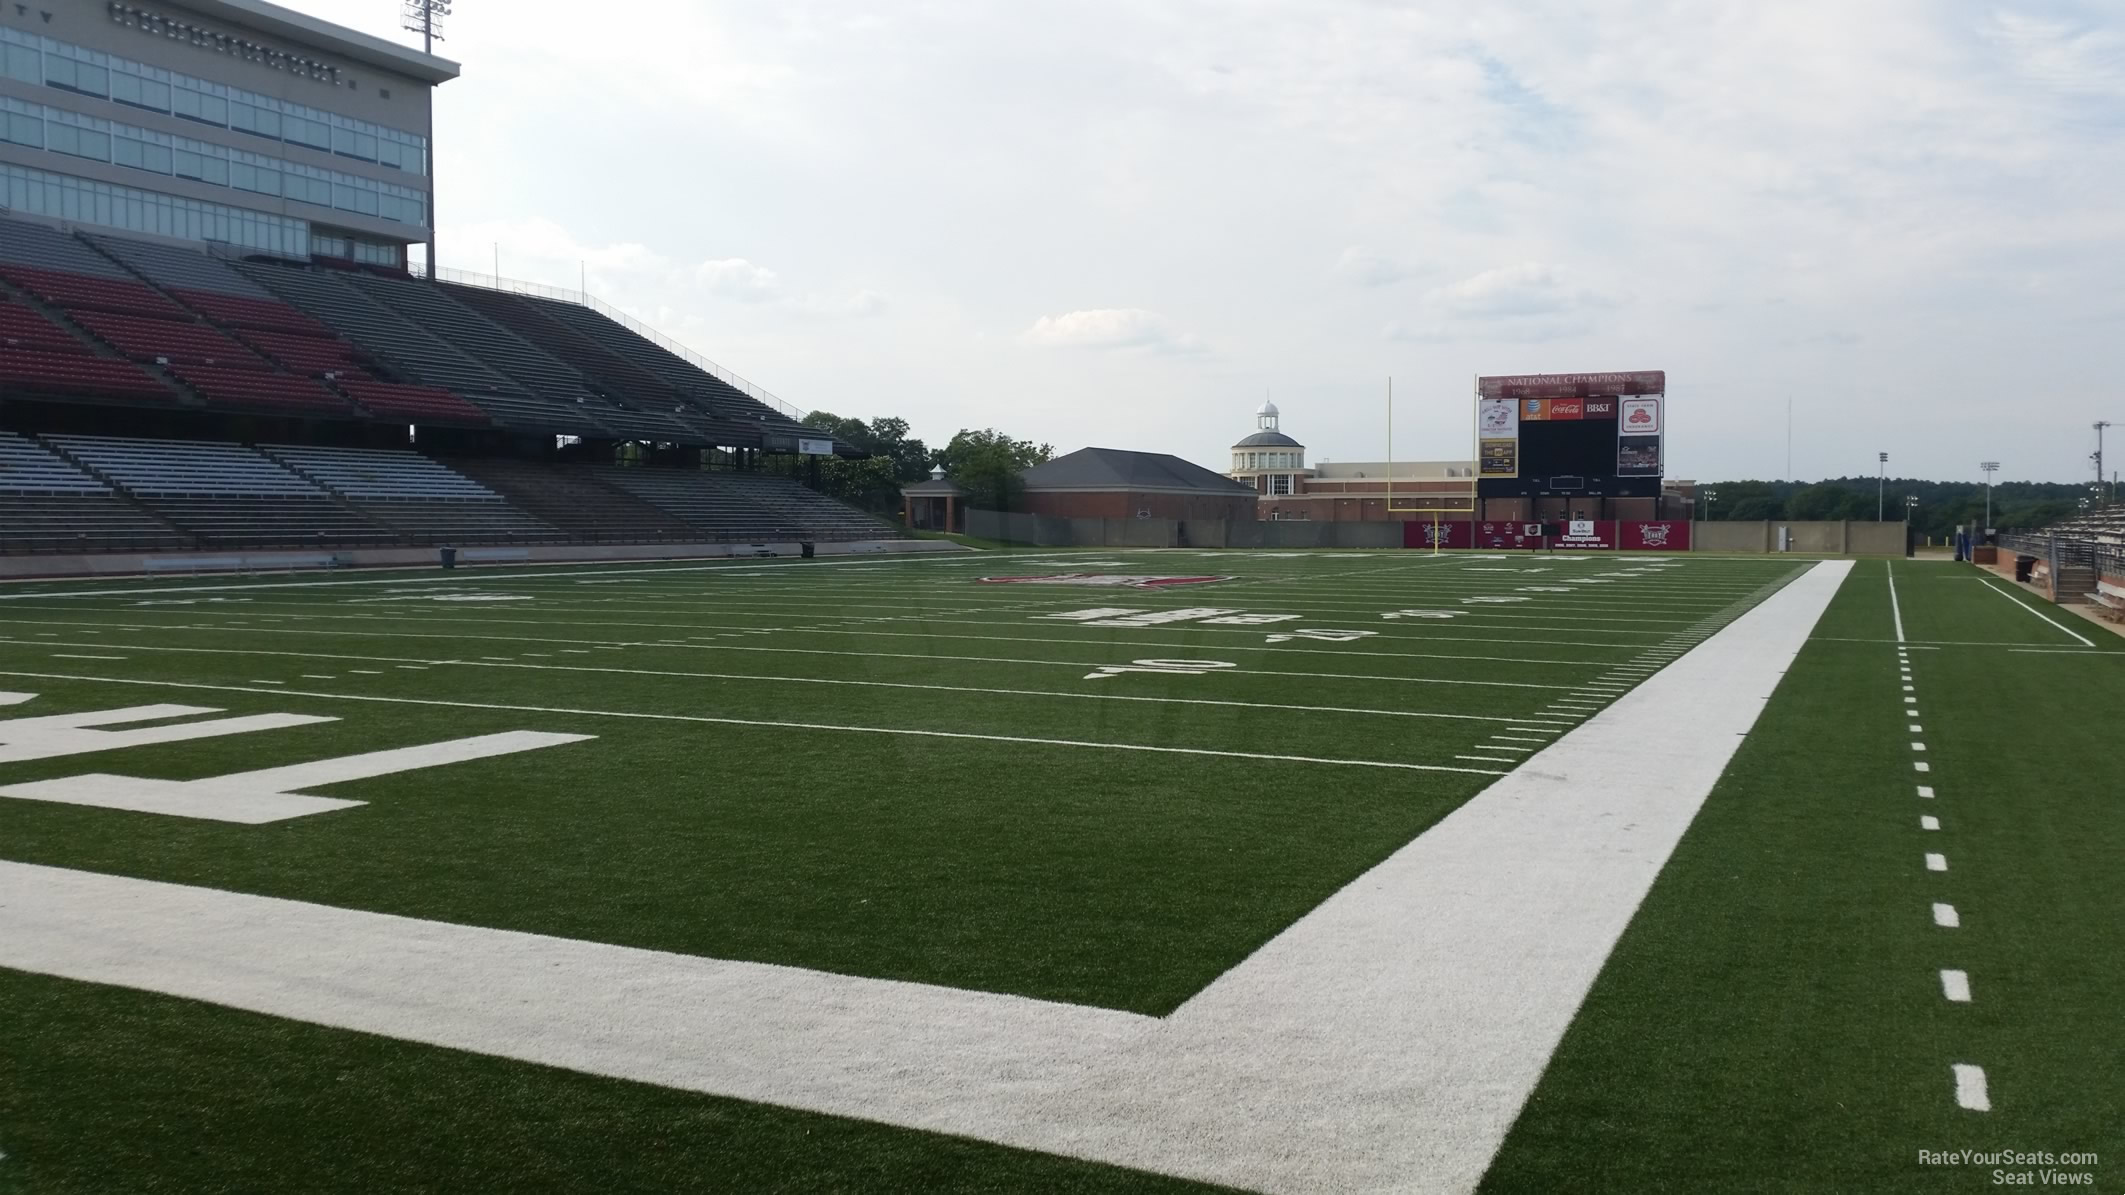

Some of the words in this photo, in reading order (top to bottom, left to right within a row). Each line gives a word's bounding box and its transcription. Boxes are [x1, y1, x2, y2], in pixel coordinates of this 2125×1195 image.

[1508, 376, 1561, 386] NATIONAL
[1564, 374, 1632, 384] CHAMPIONS
[1559, 386, 1577, 394] 1984
[1607, 385, 1625, 393] 1987
[1586, 403, 1610, 413] BB&T
[1562, 535, 1601, 543] Champions
